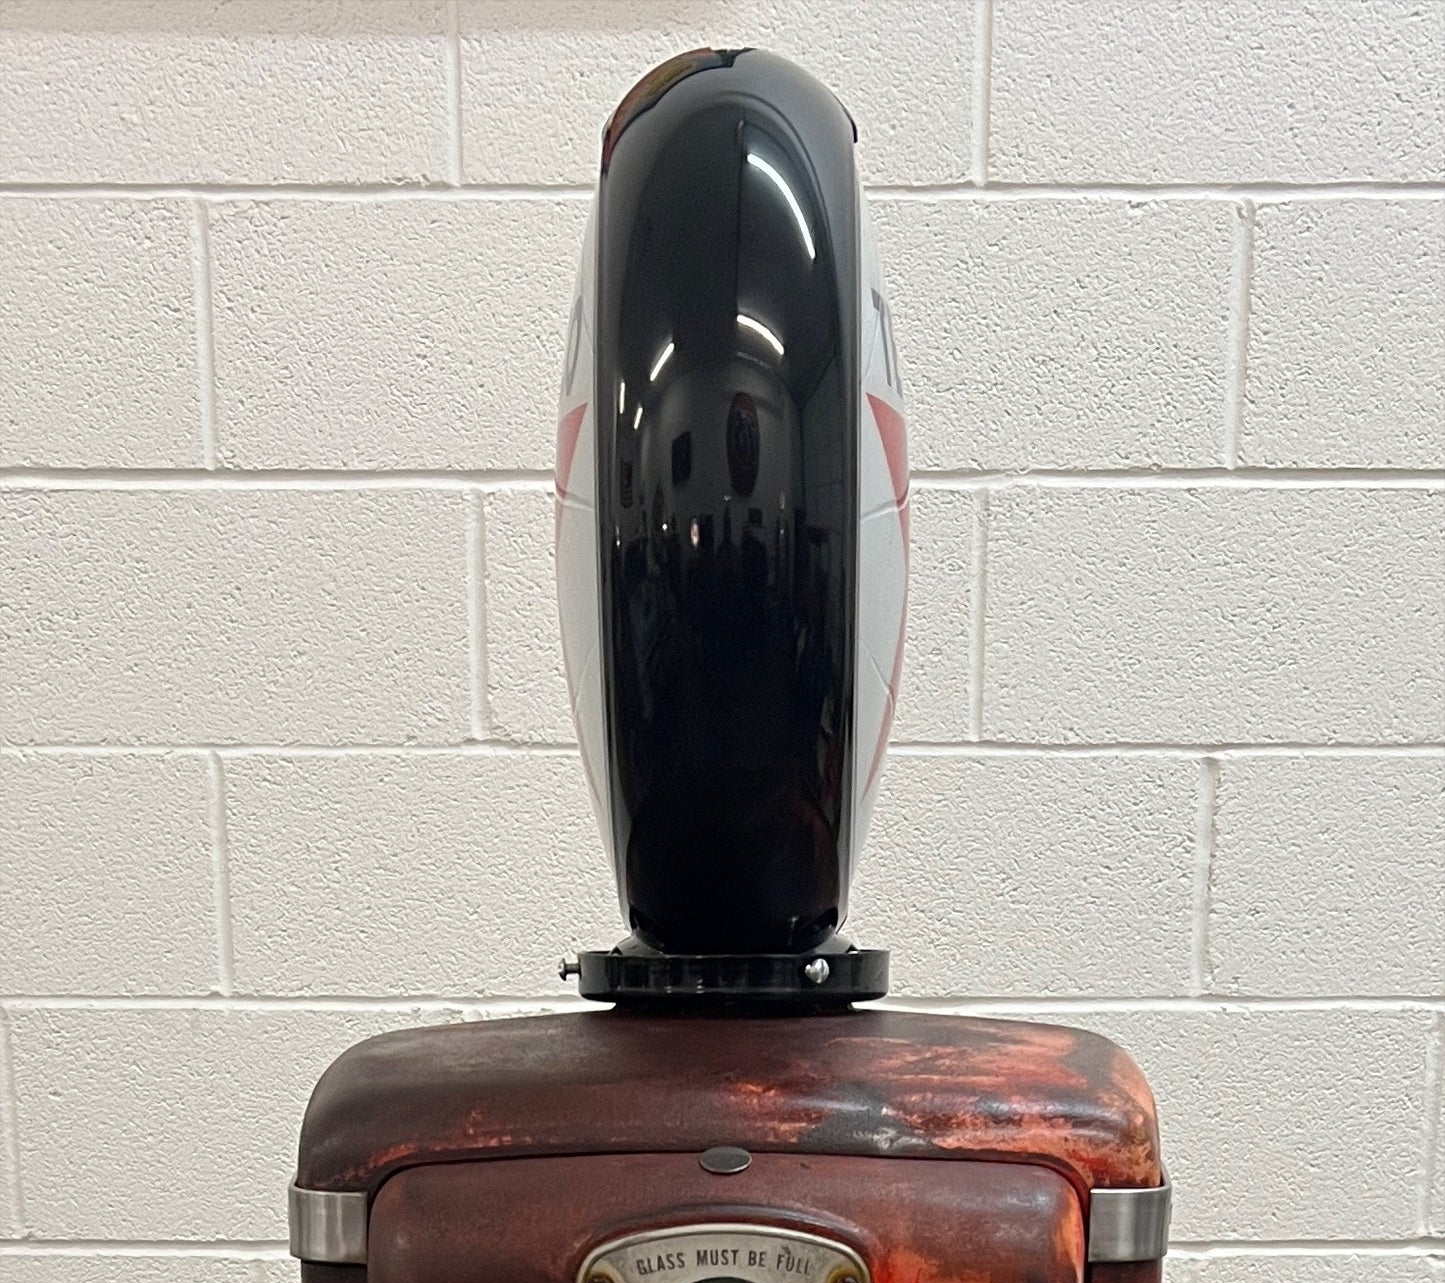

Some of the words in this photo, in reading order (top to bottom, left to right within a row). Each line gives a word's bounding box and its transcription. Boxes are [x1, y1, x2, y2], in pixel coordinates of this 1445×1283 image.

[637, 1252, 686, 1276] GLASS
[696, 1249, 739, 1267] MUST
[749, 1250, 767, 1267] BE
[776, 1252, 812, 1276] FULL
